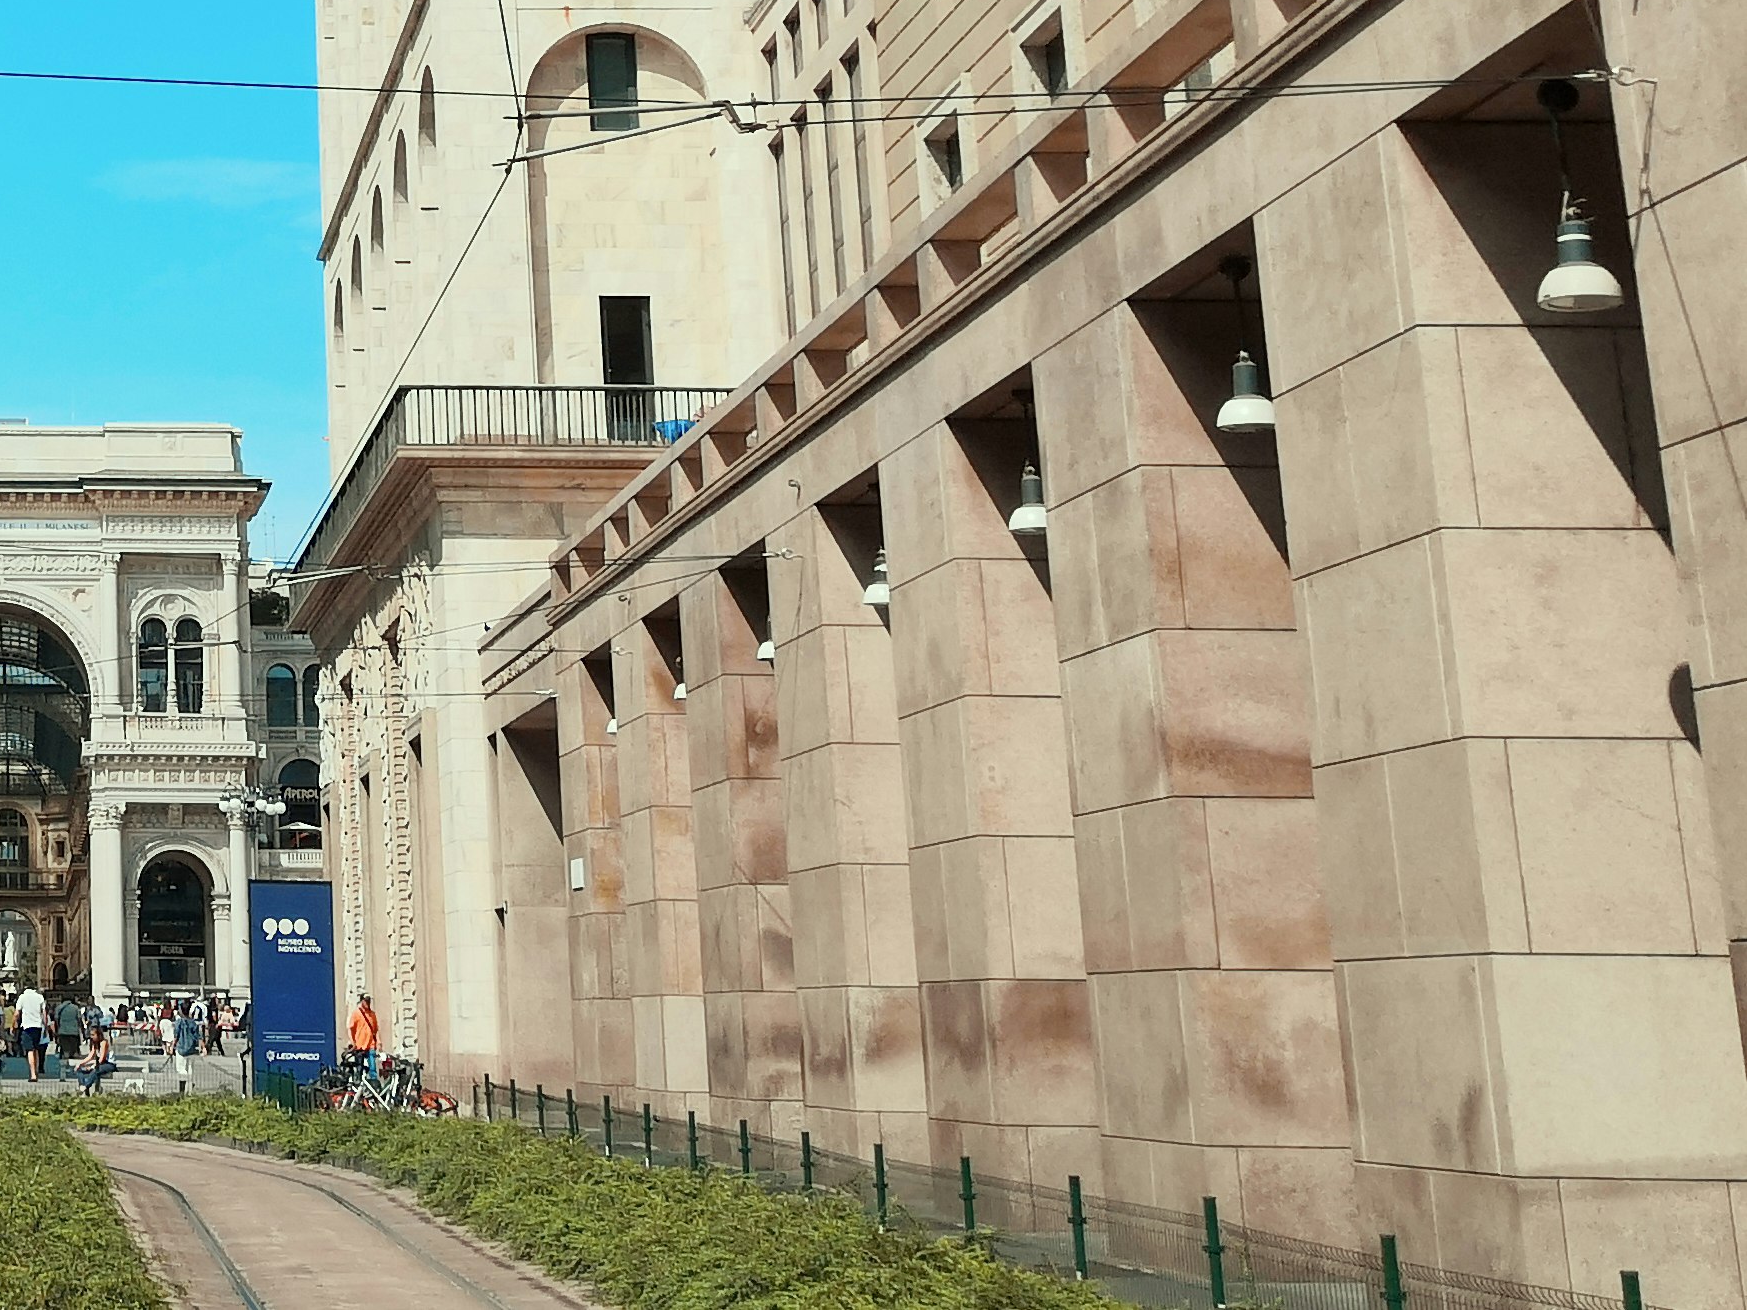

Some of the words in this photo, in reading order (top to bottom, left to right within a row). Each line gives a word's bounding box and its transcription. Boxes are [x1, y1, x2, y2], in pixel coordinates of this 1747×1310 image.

[284, 787, 319, 802] APEROL
[262, 918, 310, 940] 900
[278, 938, 302, 946] MUSEO
[304, 938, 317, 946] DEL
[278, 946, 322, 954] NOVECENTO
[276, 1053, 320, 1061] LEONARDO
